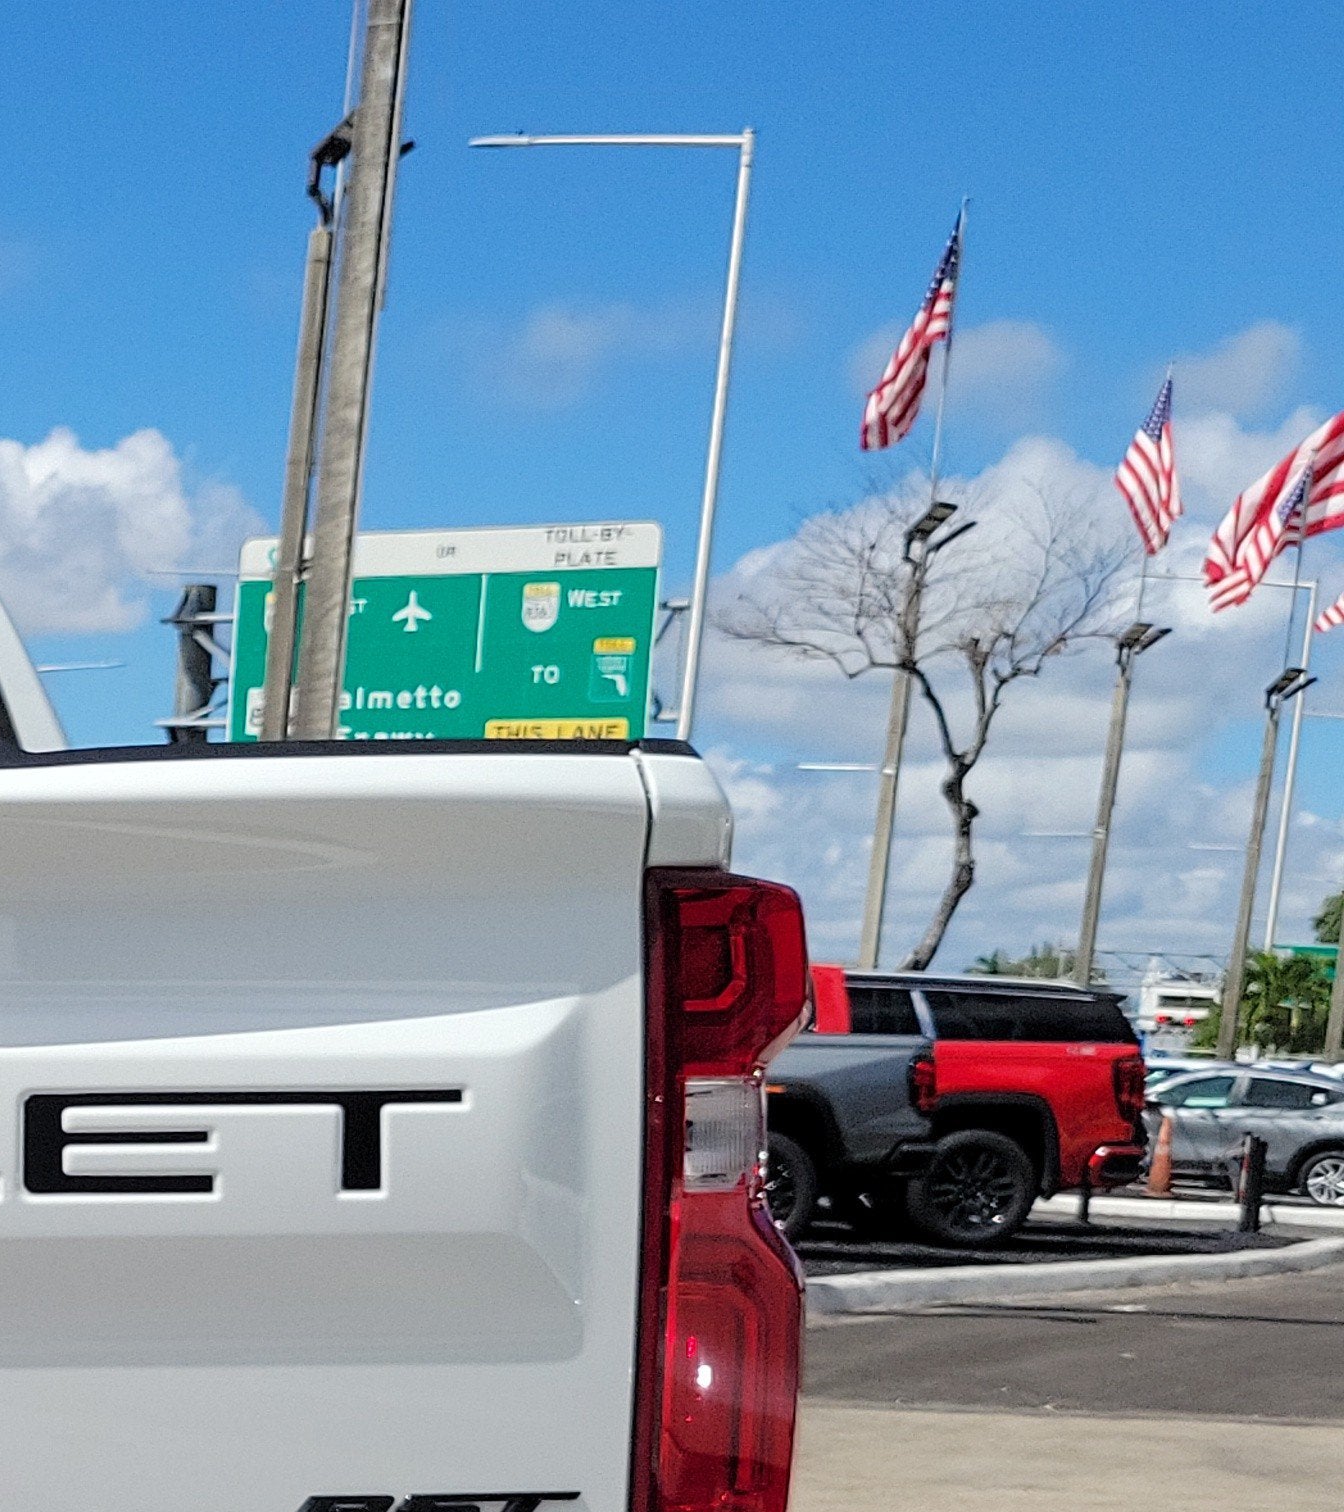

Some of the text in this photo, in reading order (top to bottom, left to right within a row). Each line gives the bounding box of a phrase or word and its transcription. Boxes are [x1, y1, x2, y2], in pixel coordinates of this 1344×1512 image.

[554, 551, 616, 567] PLATE
[568, 588, 622, 608] WEST
[532, 665, 560, 684] TO
[338, 684, 461, 710] almetto
